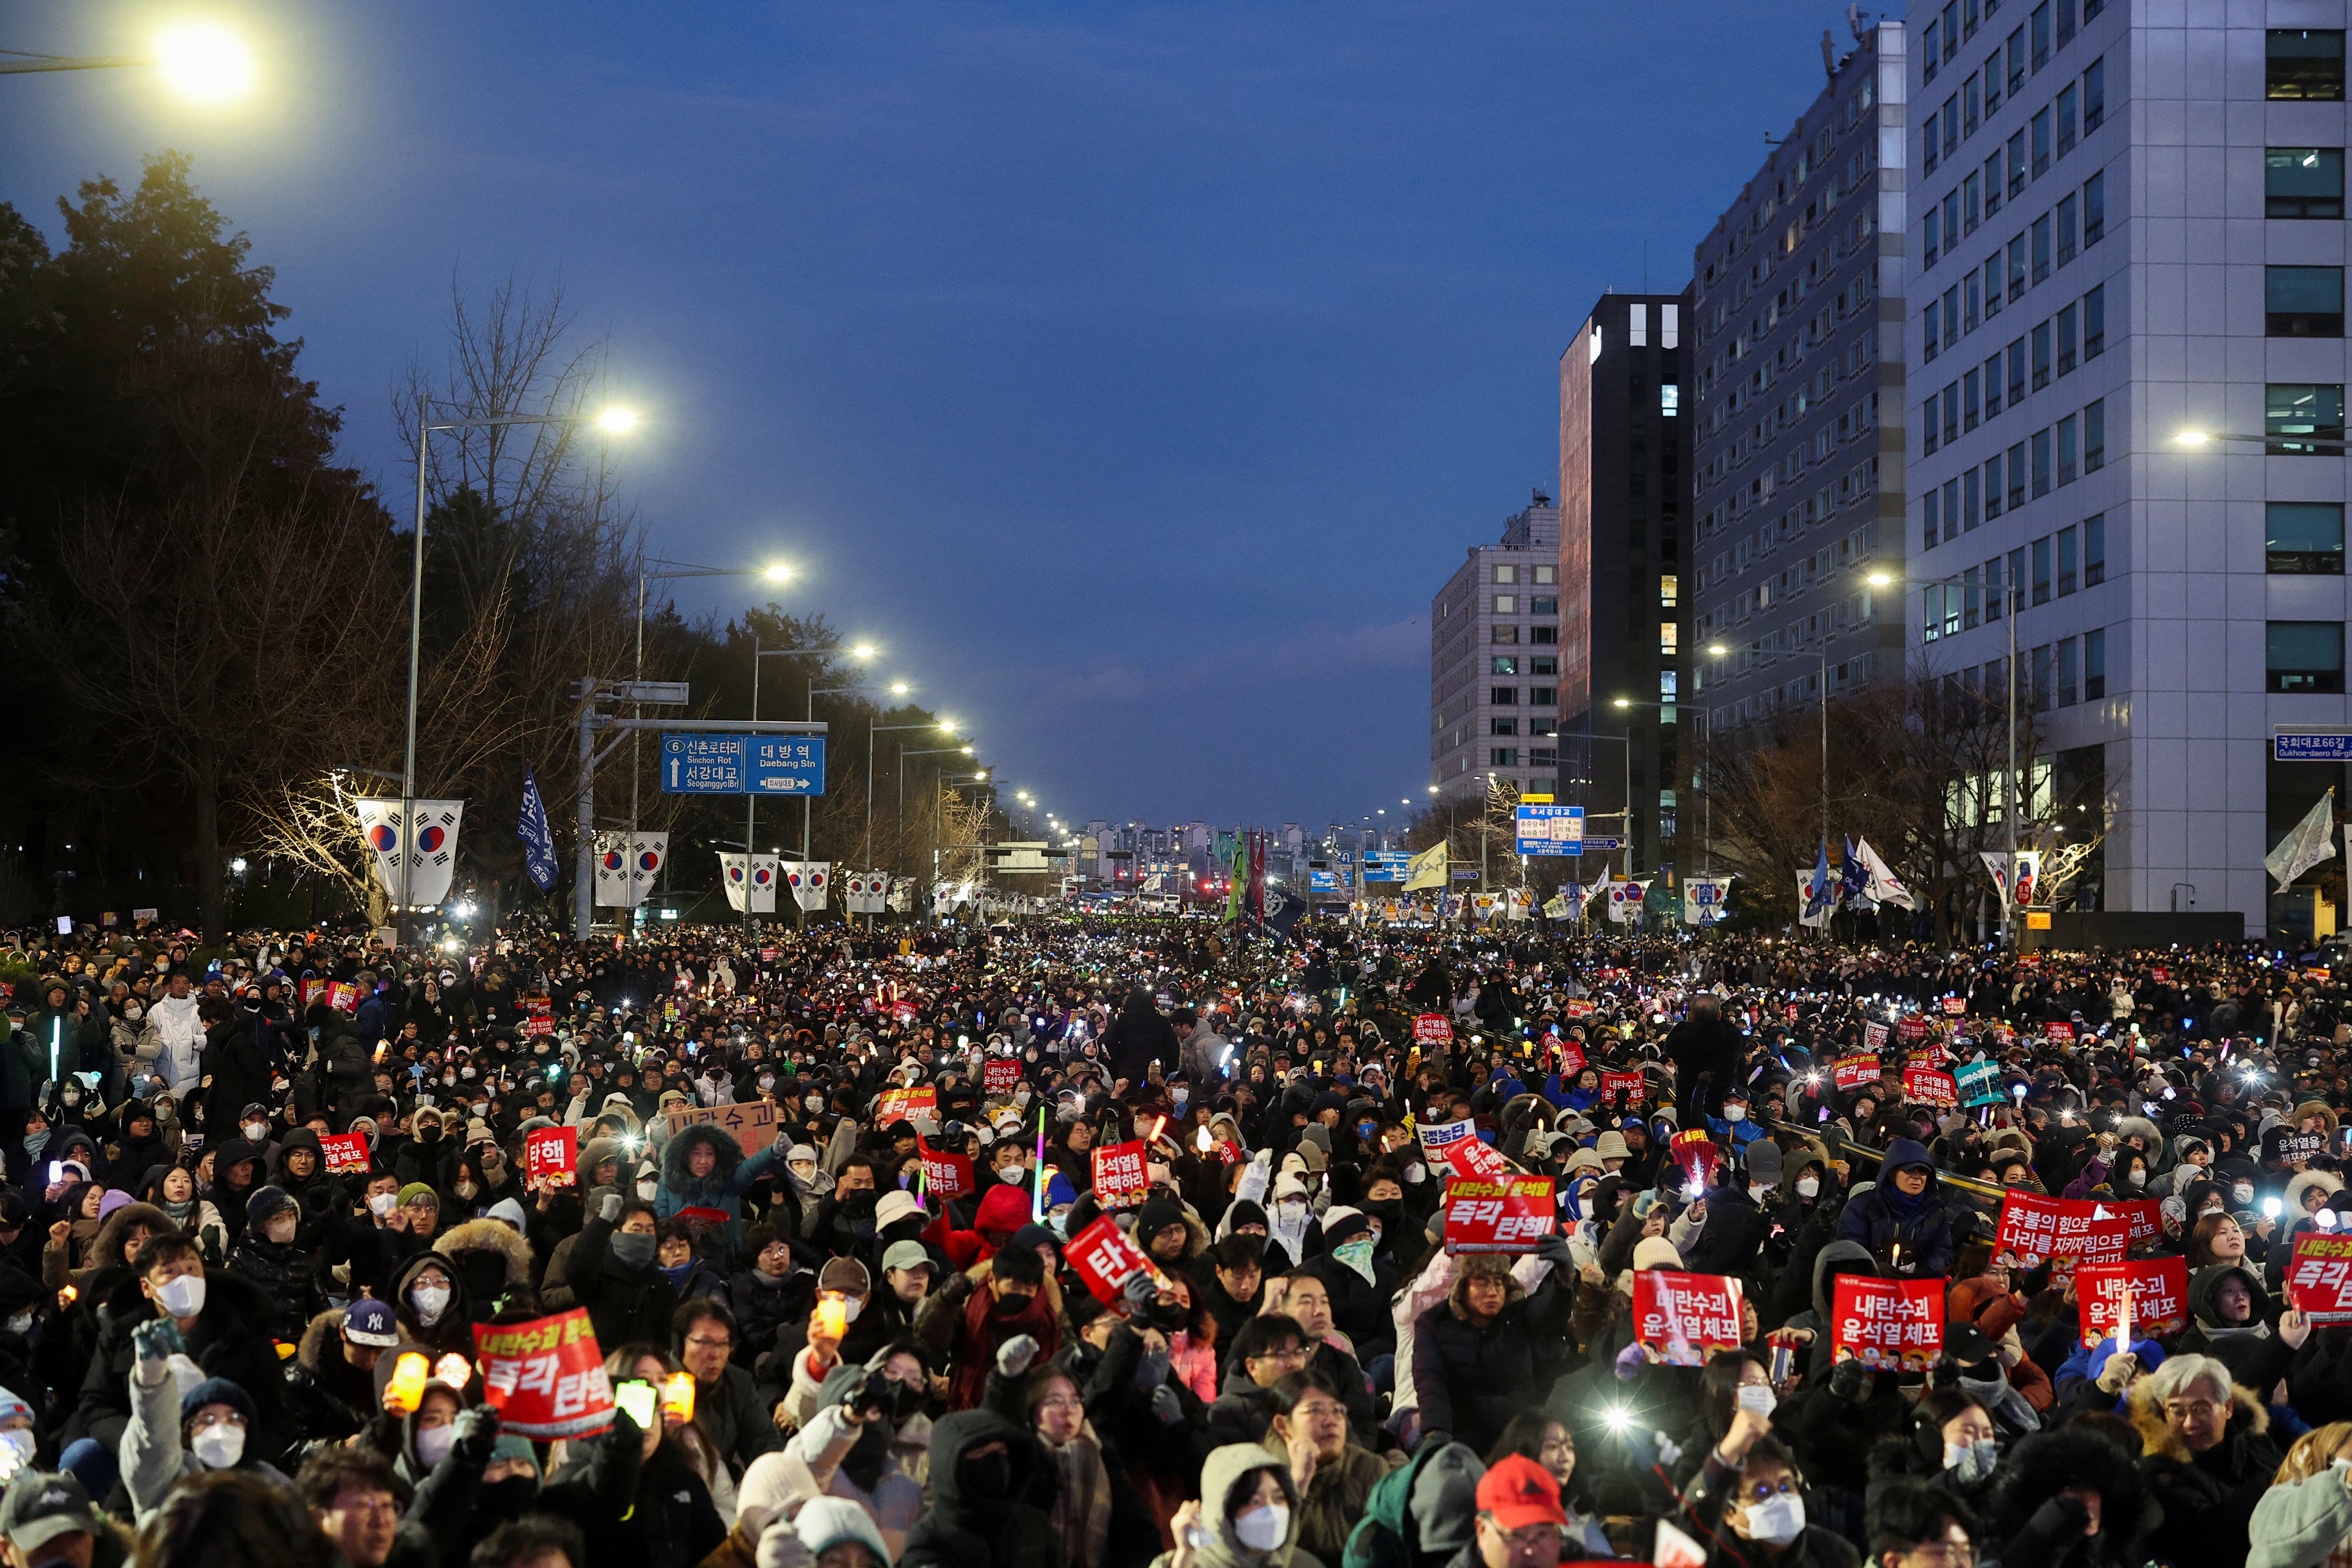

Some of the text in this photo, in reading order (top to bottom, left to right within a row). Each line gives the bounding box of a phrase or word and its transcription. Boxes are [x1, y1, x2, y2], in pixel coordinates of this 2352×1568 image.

[672, 742, 679, 751] 6
[687, 741, 740, 755] 신촌로터리
[2279, 737, 2345, 749] 국회대로66길
[761, 745, 810, 759] 대방역
[2279, 749, 2330, 757] Gukhoe-daero
[760, 760, 798, 769] Daebang
[686, 767, 737, 780] 서강대교
[687, 779, 739, 789] Seoganggyo(Br)
[769, 780, 792, 788] 의사당대로
[307, 979, 325, 989] 내란죄
[335, 983, 357, 996] 내란죄
[333, 991, 355, 1004] 윤석열
[899, 1004, 916, 1013] 내란수괴
[1416, 1019, 1448, 1029] 윤석열을
[1416, 1028, 1449, 1037] 탄핵하라
[1834, 1055, 1877, 1069] 내란수괴 윤석열
[988, 1066, 1016, 1076] 내란수괴
[1836, 1064, 1880, 1081] 즉각 탄핵!
[984, 1076, 1005, 1085] 윤석열
[1609, 1079, 1640, 1089] 내란수괴
[1913, 1073, 1951, 1087] 윤석열을
[910, 1089, 934, 1098] 윤석열
[1630, 1090, 1644, 1101] 체포
[1913, 1085, 1951, 1098] 탄핵하라
[1421, 1123, 1466, 1144] 국정농단
[321, 1140, 354, 1155] 란수괴
[2278, 1136, 2320, 1152] 윤석열을
[342, 1149, 363, 1161] 체포
[529, 1139, 565, 1172] 탄핵
[922, 1158, 958, 1179] 석열을
[1096, 1153, 1141, 1178] 윤석열을
[1097, 1172, 1144, 1194] 탄핵하라
[1449, 1181, 1551, 1197] 내란수괴 윤석열
[1449, 1200, 1504, 1225] 즉각
[2006, 1207, 2092, 1234] 촛불의 힘으로
[2128, 1224, 2155, 1239] 체포
[2003, 1228, 2086, 1253] 나라를 지키자
[2084, 1233, 2124, 1252] 힘으로
[2292, 1261, 2349, 1290] 즉각
[2096, 1275, 2166, 1300] 내란수괴
[1656, 1288, 1727, 1316] 내란수괴
[1855, 1295, 1929, 1320] 내란수괴
[2141, 1297, 2178, 1320] 체포
[367, 1313, 383, 1331] NY
[1702, 1315, 1738, 1339] 체포
[1842, 1318, 1939, 1347] 윤석열 체포
[487, 1354, 560, 1397] 즉각
